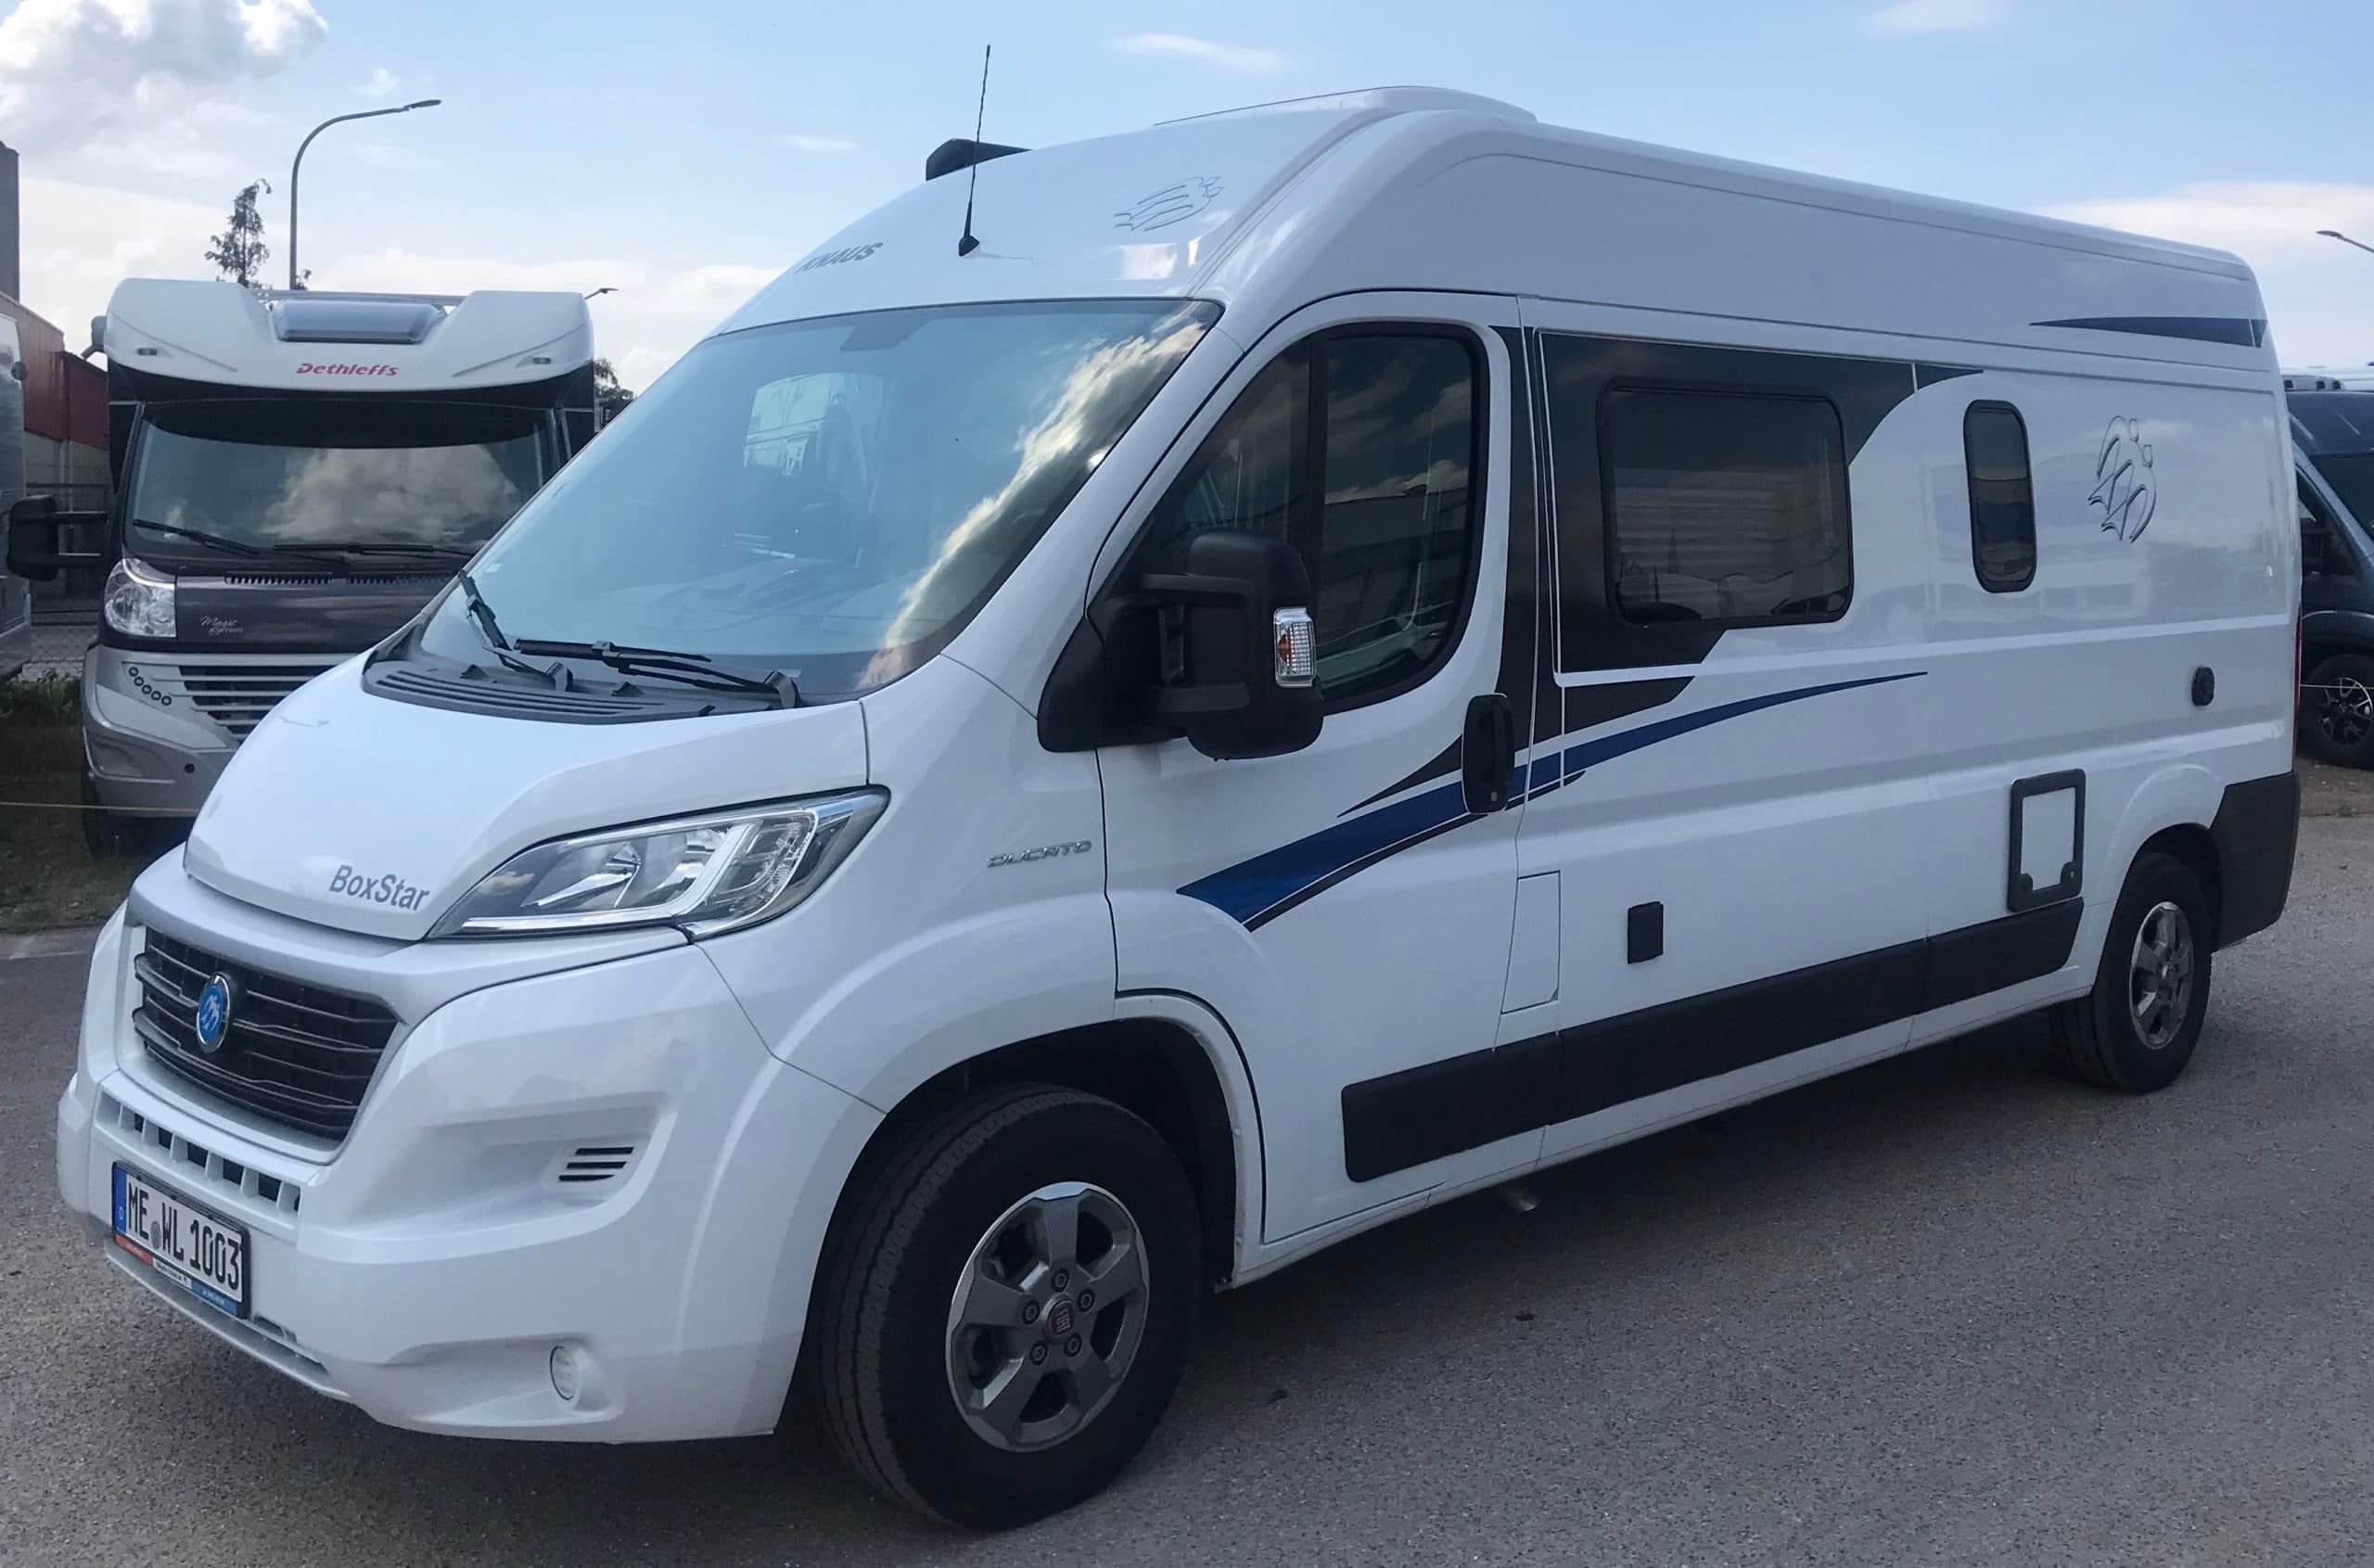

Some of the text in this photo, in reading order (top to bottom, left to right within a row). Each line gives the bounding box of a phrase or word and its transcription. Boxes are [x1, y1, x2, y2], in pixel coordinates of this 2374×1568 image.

[793, 242, 884, 274] KNAUS
[296, 363, 399, 376] Dethleffs
[988, 840, 1091, 868] DUCATO
[329, 864, 430, 911] BoxStar
[128, 1182, 149, 1240] ME
[162, 1203, 185, 1261] WL
[190, 1218, 240, 1291] 1003
